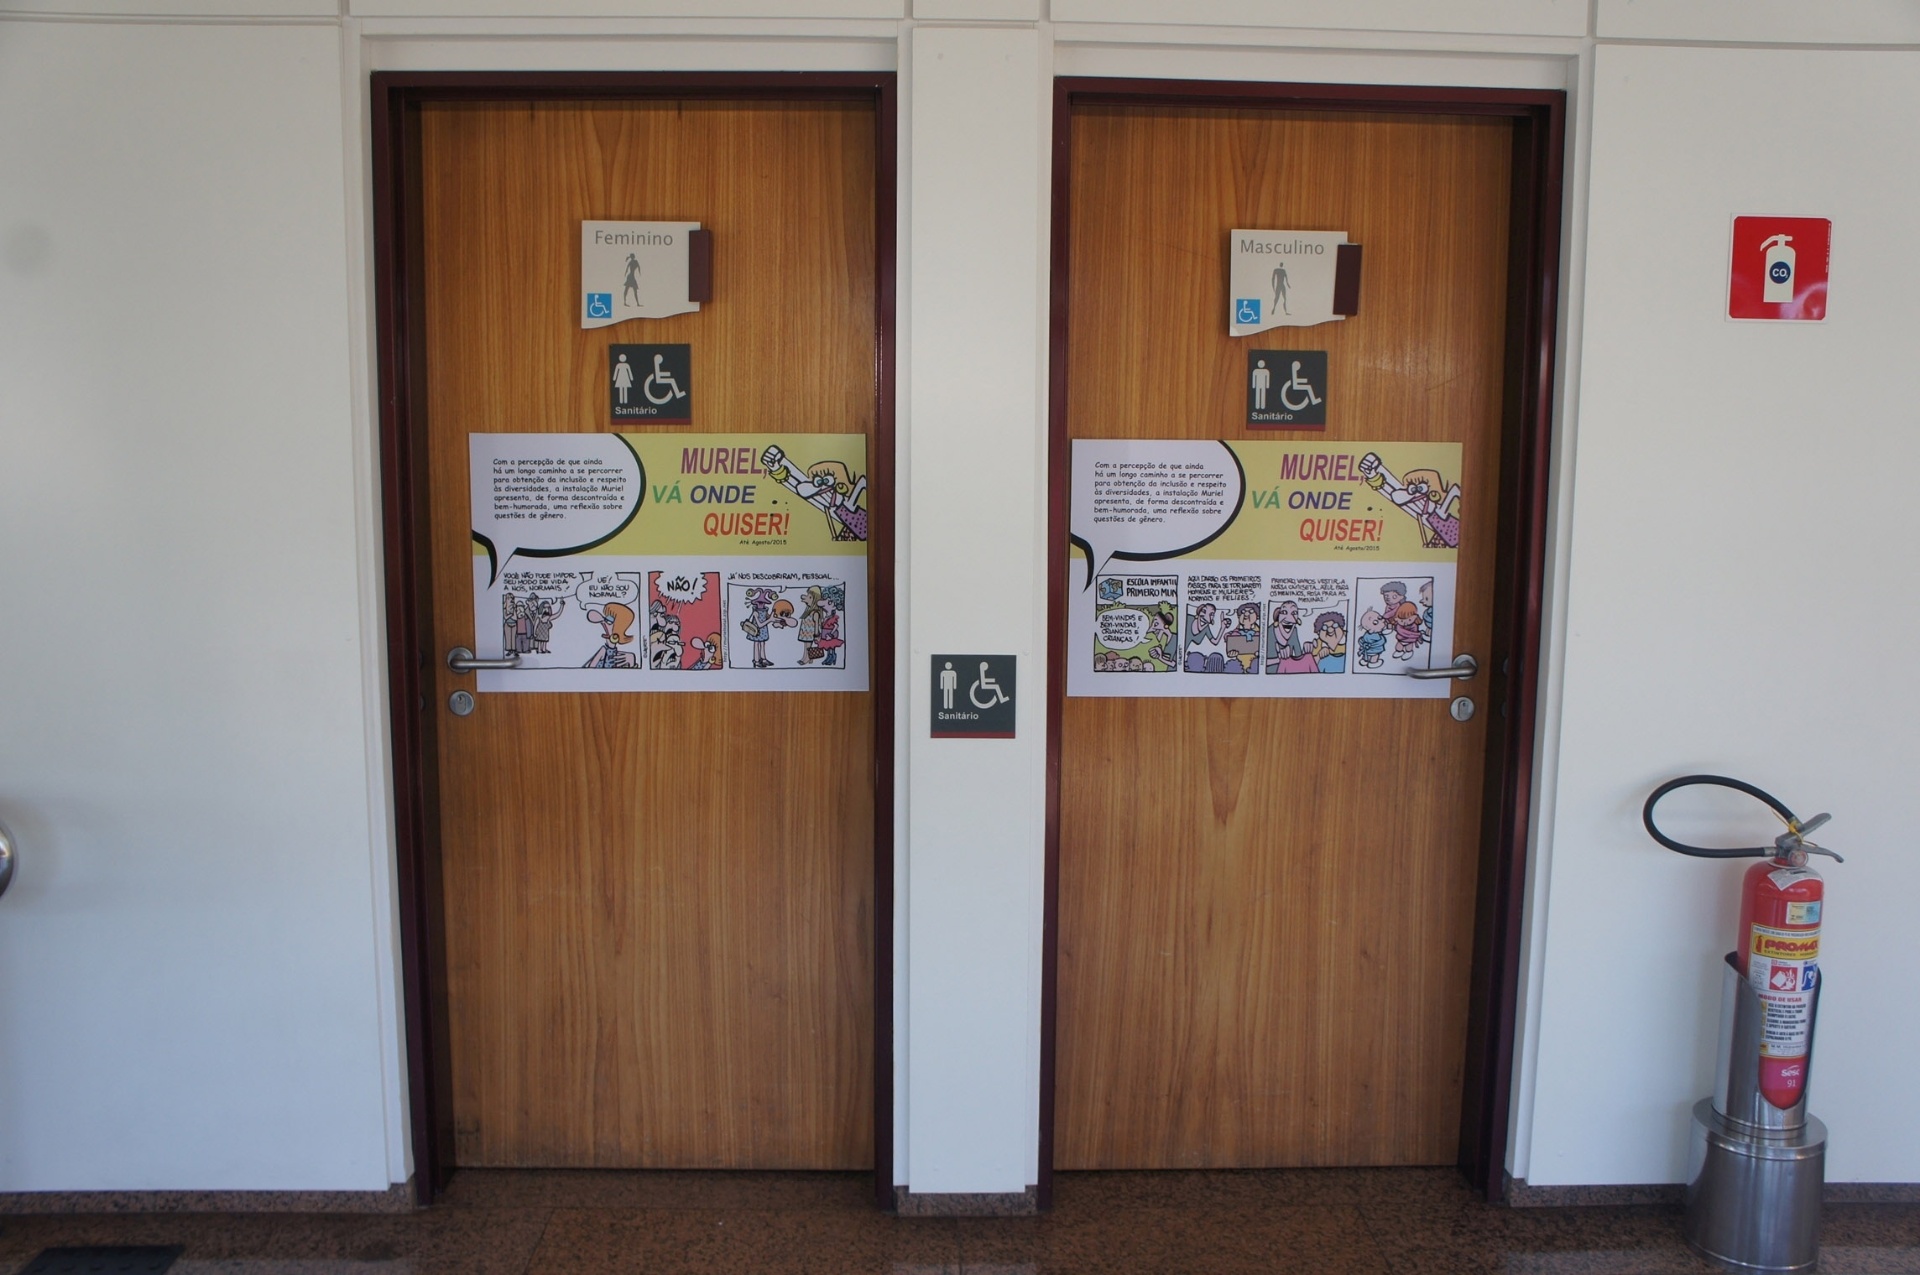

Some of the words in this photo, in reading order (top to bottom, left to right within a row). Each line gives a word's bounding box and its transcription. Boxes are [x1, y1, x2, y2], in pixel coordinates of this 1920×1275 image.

[595, 230, 673, 246] Feminino
[1240, 239, 1324, 255] Masculino
[615, 406, 657, 415] Sanitário
[1251, 412, 1293, 420] Sanitário
[518, 459, 553, 467] percepção
[681, 448, 768, 479] MURIEL,
[1120, 462, 1155, 470] percepção
[518, 468, 535, 476] longo
[1280, 454, 1365, 486] MURIEL,
[1119, 471, 1137, 479] longo
[513, 477, 544, 485] obtenção
[1114, 480, 1145, 488] obtenção
[1198, 481, 1226, 489] respeito
[652, 481, 682, 503] VÁ
[690, 485, 756, 504] ONDE
[494, 494, 531, 502] apresenta,
[1252, 486, 1280, 509] VÁ
[1288, 492, 1352, 510] ONDE
[495, 512, 525, 520] questões
[540, 512, 566, 520] gênero.
[1139, 516, 1165, 524] gênero.
[703, 513, 790, 536] QUISER!
[1300, 519, 1383, 542] QUISER!
[667, 576, 697, 595] NÃO!
[1127, 578, 1149, 586] ESCOLA
[1126, 588, 1160, 597] PRIMEIRO
